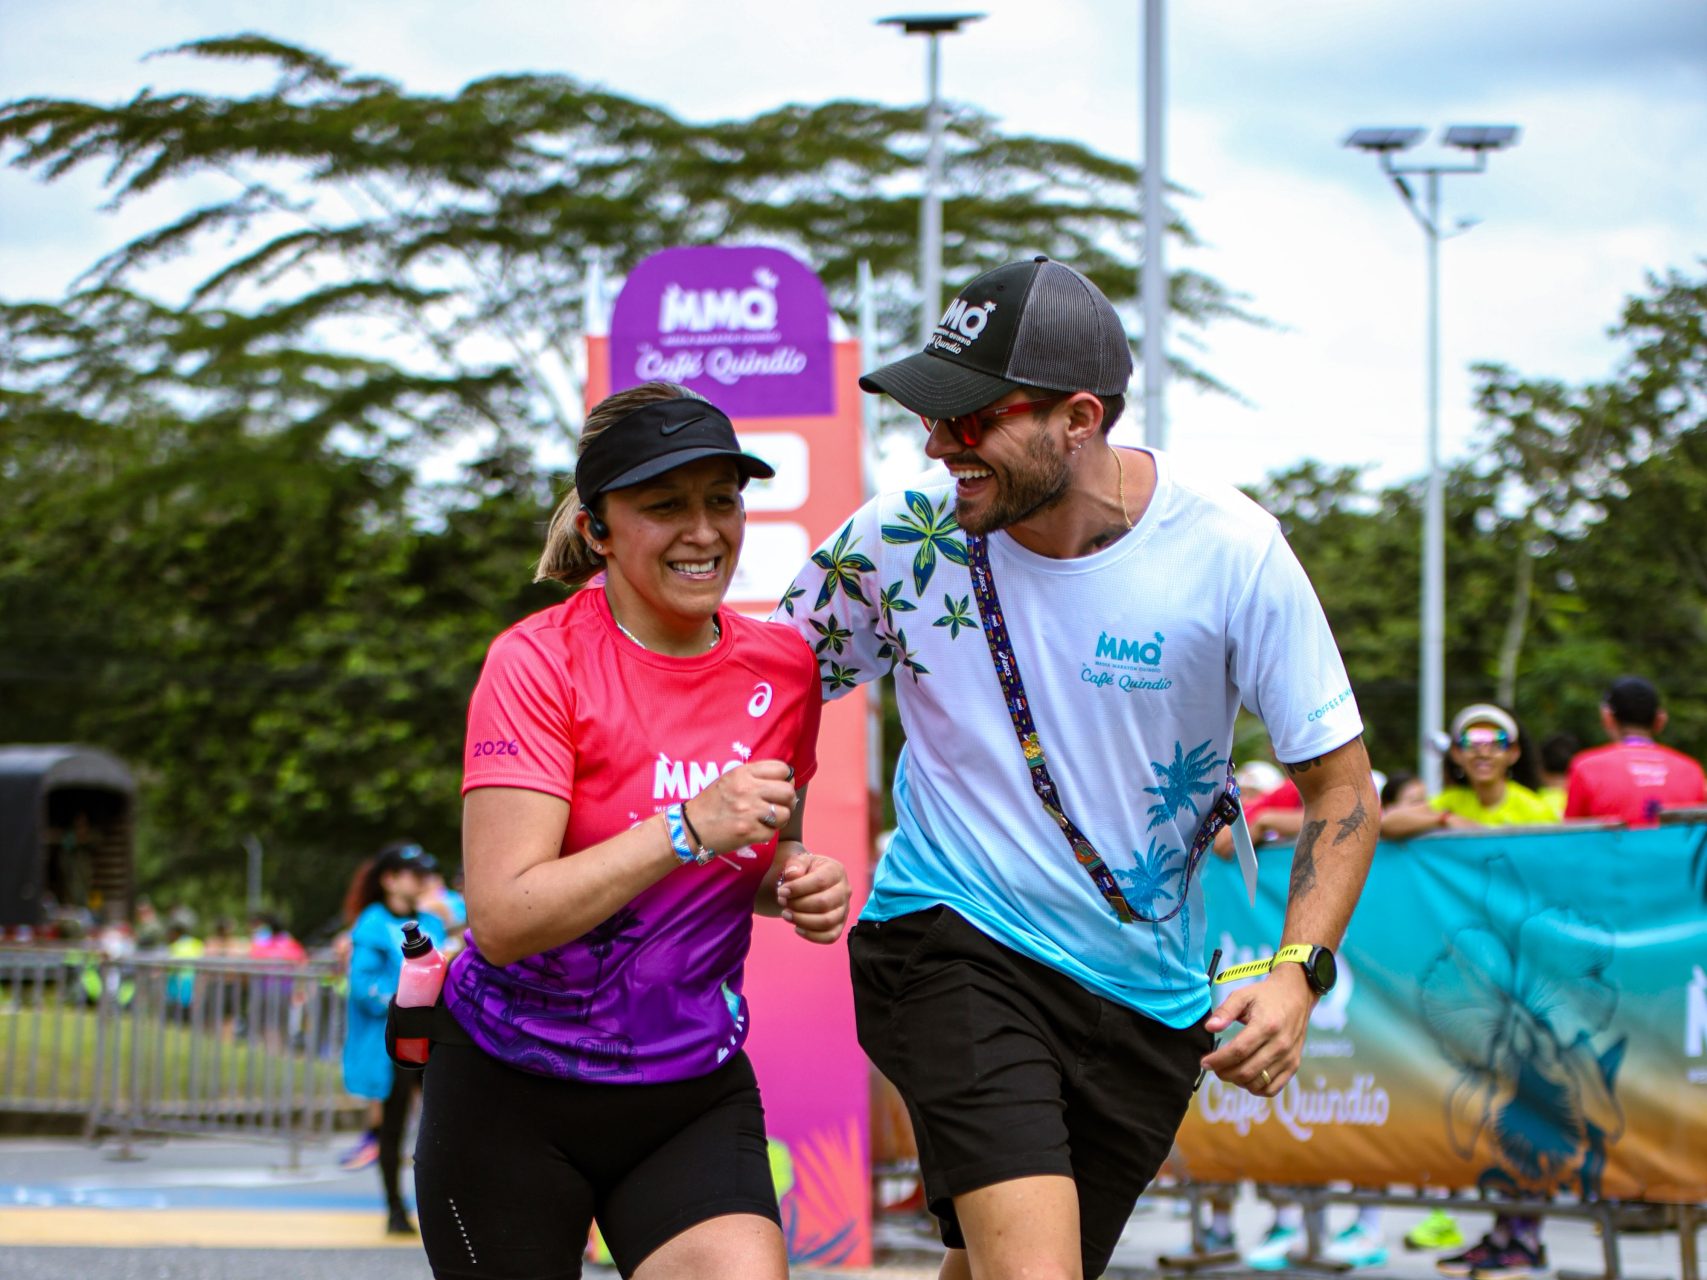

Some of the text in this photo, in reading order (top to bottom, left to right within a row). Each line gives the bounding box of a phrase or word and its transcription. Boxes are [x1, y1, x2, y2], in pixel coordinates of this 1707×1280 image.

[1096, 632, 1162, 666] MMQ
[1081, 668, 1173, 693] Café Quindío
[1307, 698, 1339, 722] COFFEE
[473, 739, 518, 757] 2026
[653, 760, 743, 800] MM
